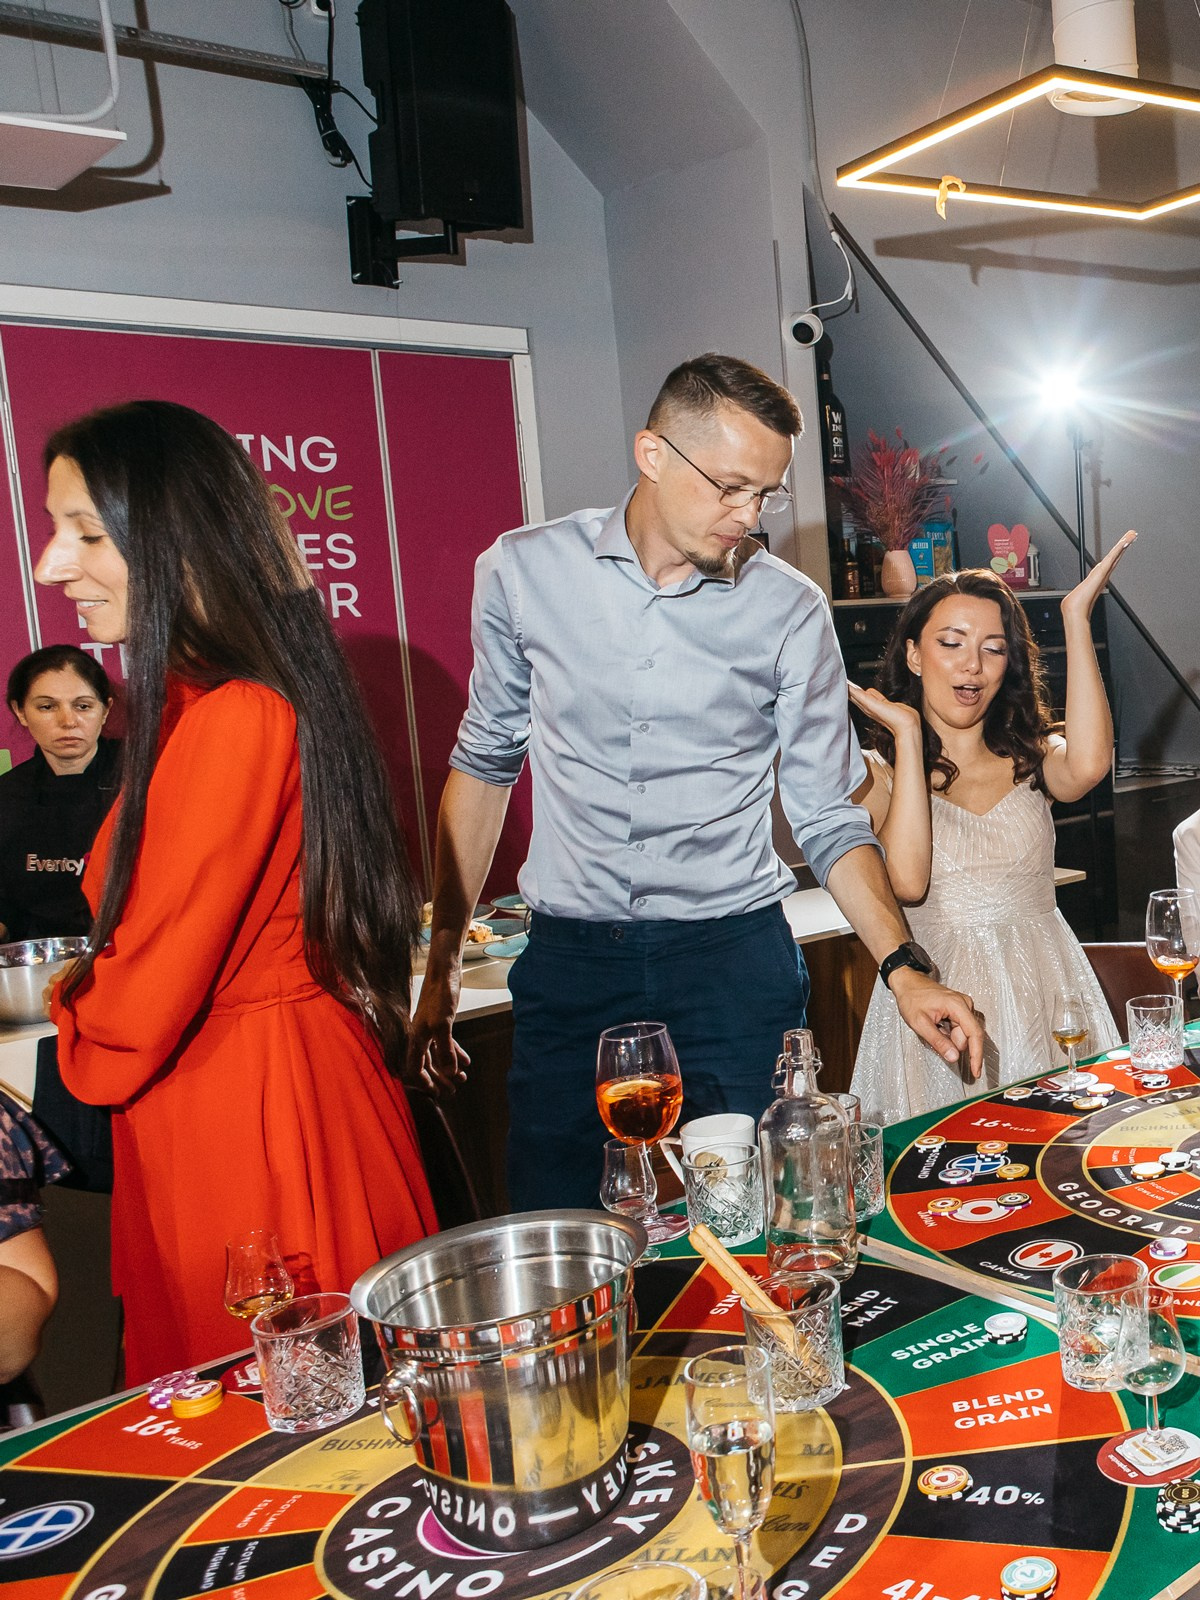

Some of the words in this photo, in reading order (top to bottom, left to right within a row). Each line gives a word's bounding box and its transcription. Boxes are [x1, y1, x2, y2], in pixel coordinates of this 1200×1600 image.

[979, 1260, 1033, 1281] CANADA
[847, 1296, 900, 1328] MALT
[890, 1322, 983, 1361] SINGLE
[952, 1388, 1045, 1413] BLEND
[954, 1403, 1053, 1430] GRAIN
[122, 1415, 183, 1437] 16+
[166, 1436, 204, 1451] YEARS
[965, 1485, 1046, 1506] 40%
[236, 1498, 274, 1529] ISLAND
[258, 1494, 303, 1533] SCOTLAND
[233, 1540, 260, 1582] SCOTLAND
[345, 1496, 504, 1600] CASINO
[201, 1545, 230, 1590] HIGHLAND
